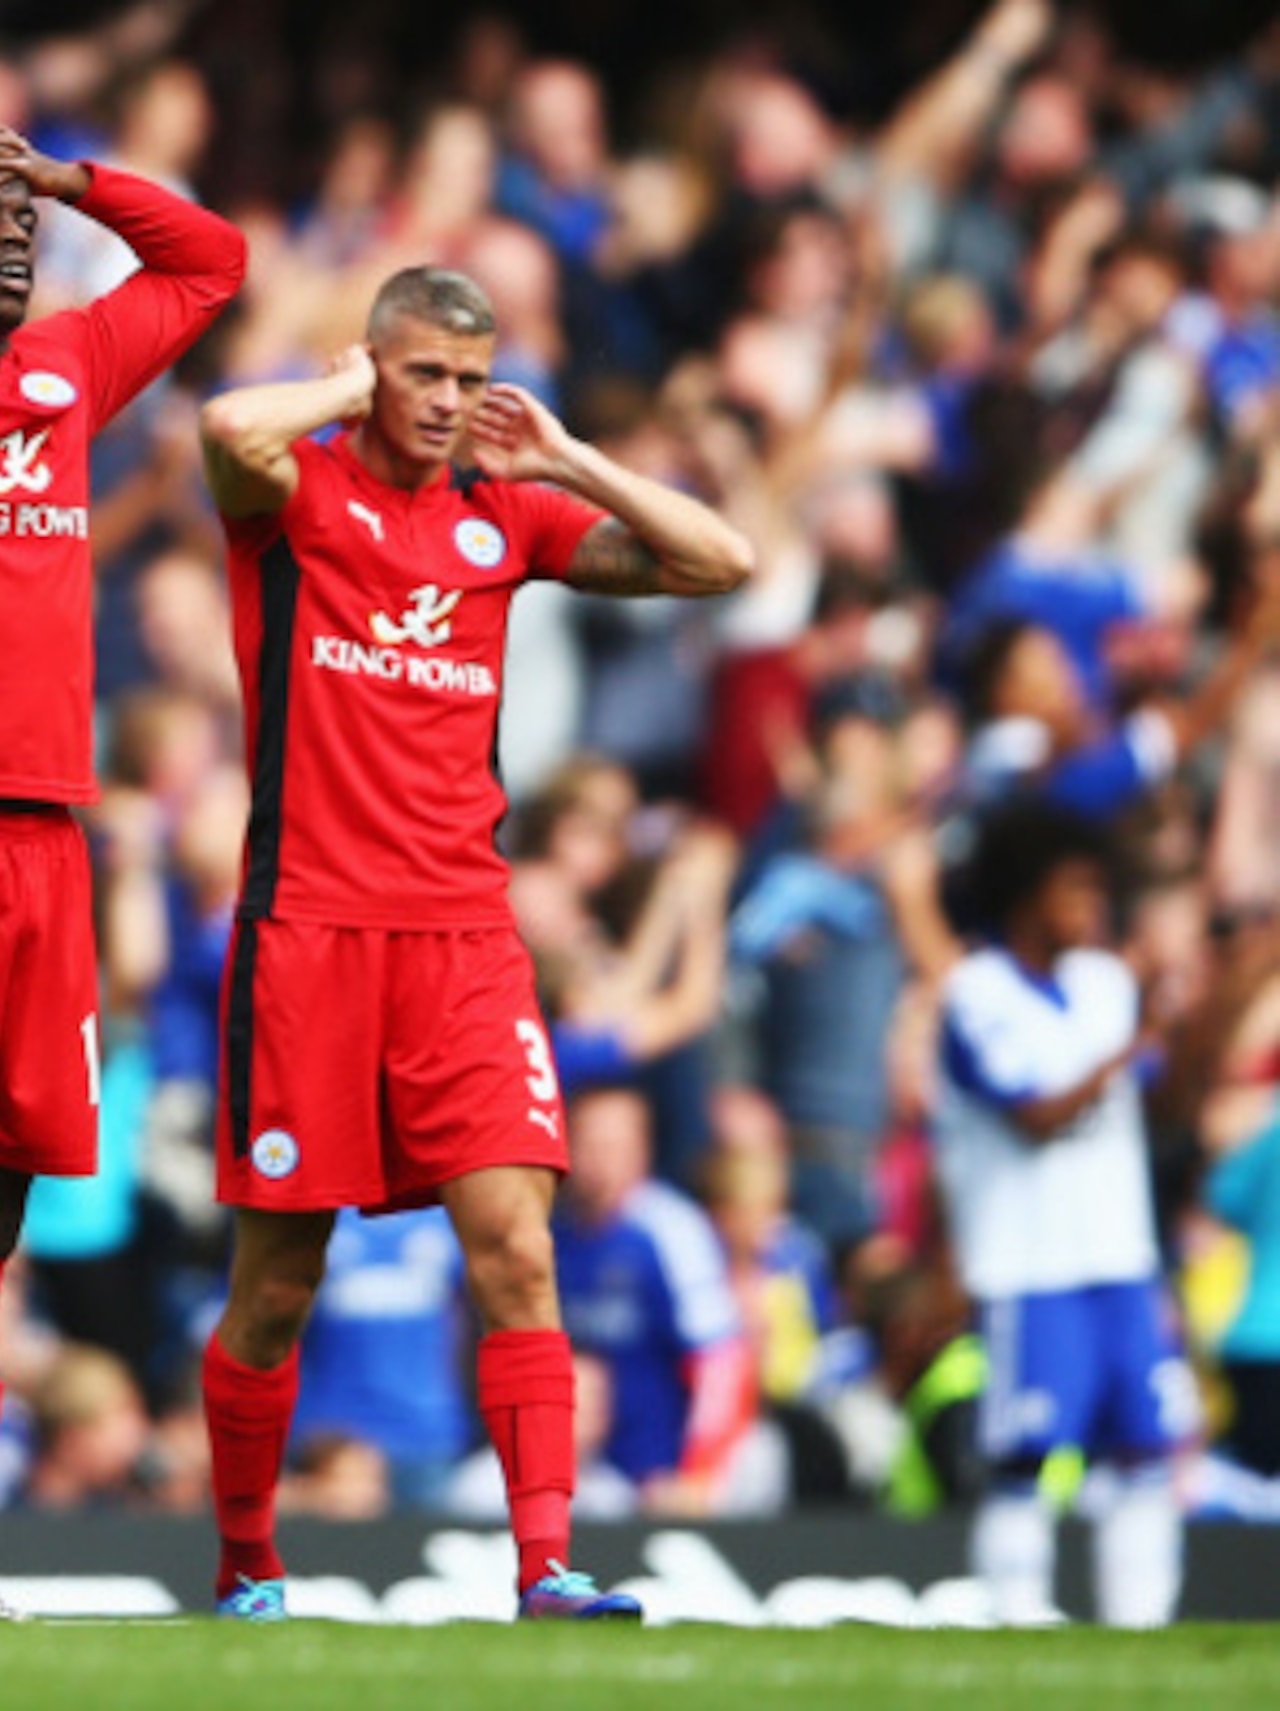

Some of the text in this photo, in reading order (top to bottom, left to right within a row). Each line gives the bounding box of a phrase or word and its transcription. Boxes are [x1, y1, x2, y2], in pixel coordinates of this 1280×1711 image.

[312, 634, 497, 696] KING POWER
[515, 1018, 558, 1102] 3
